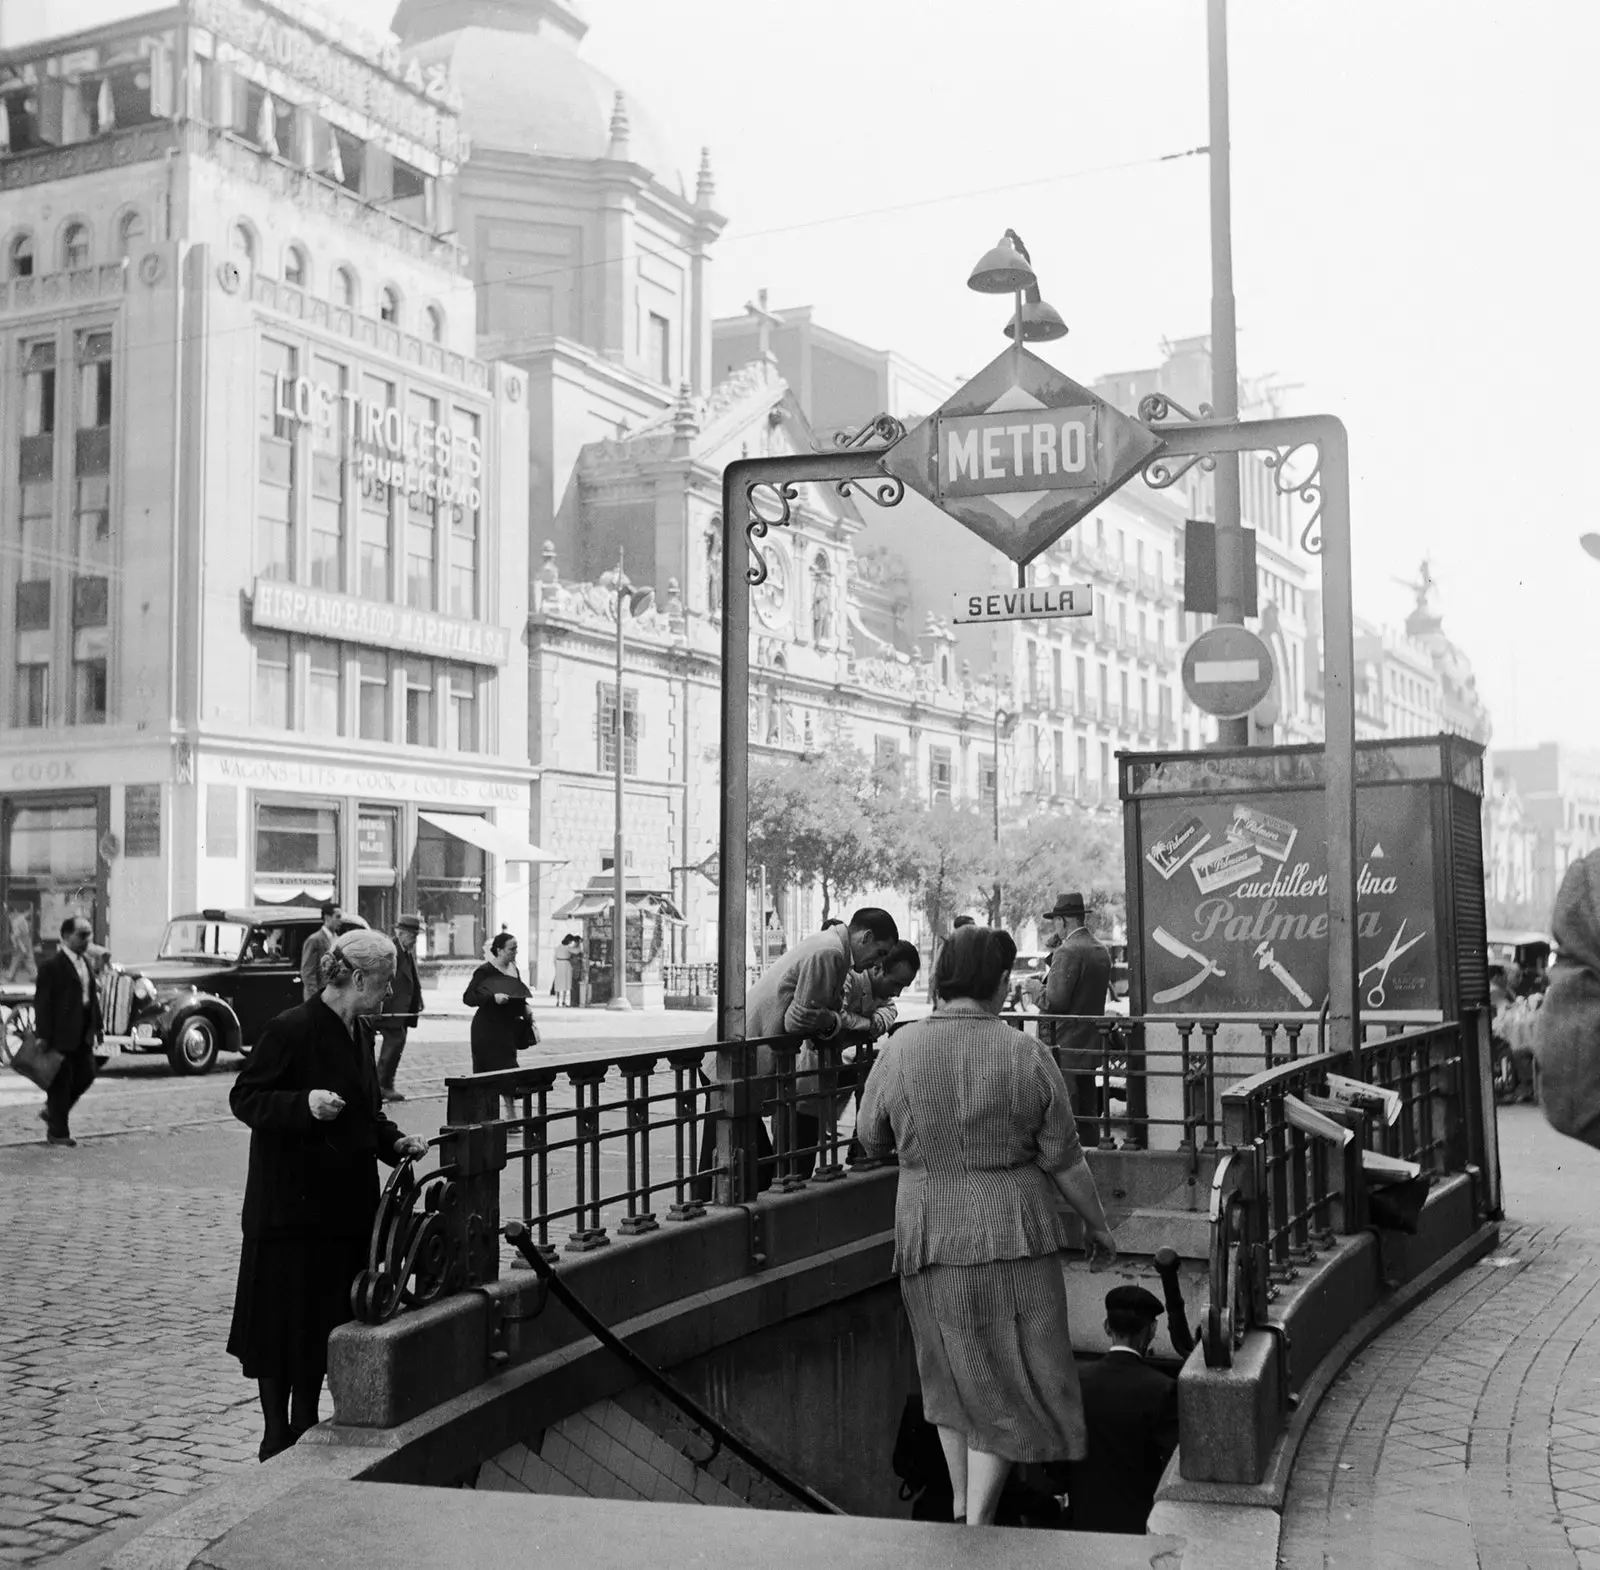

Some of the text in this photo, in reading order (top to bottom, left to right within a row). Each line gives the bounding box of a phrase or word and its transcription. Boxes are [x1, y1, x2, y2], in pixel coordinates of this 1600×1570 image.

[276, 368, 481, 479] LOS TIROLESES
[948, 420, 1086, 482] METRO
[363, 451, 480, 510] PUBLICIDAD
[968, 590, 1074, 616] SEVILLA
[11, 758, 76, 783] COOK
[1356, 862, 1398, 902] fina
[1192, 898, 1383, 943] Palmea
